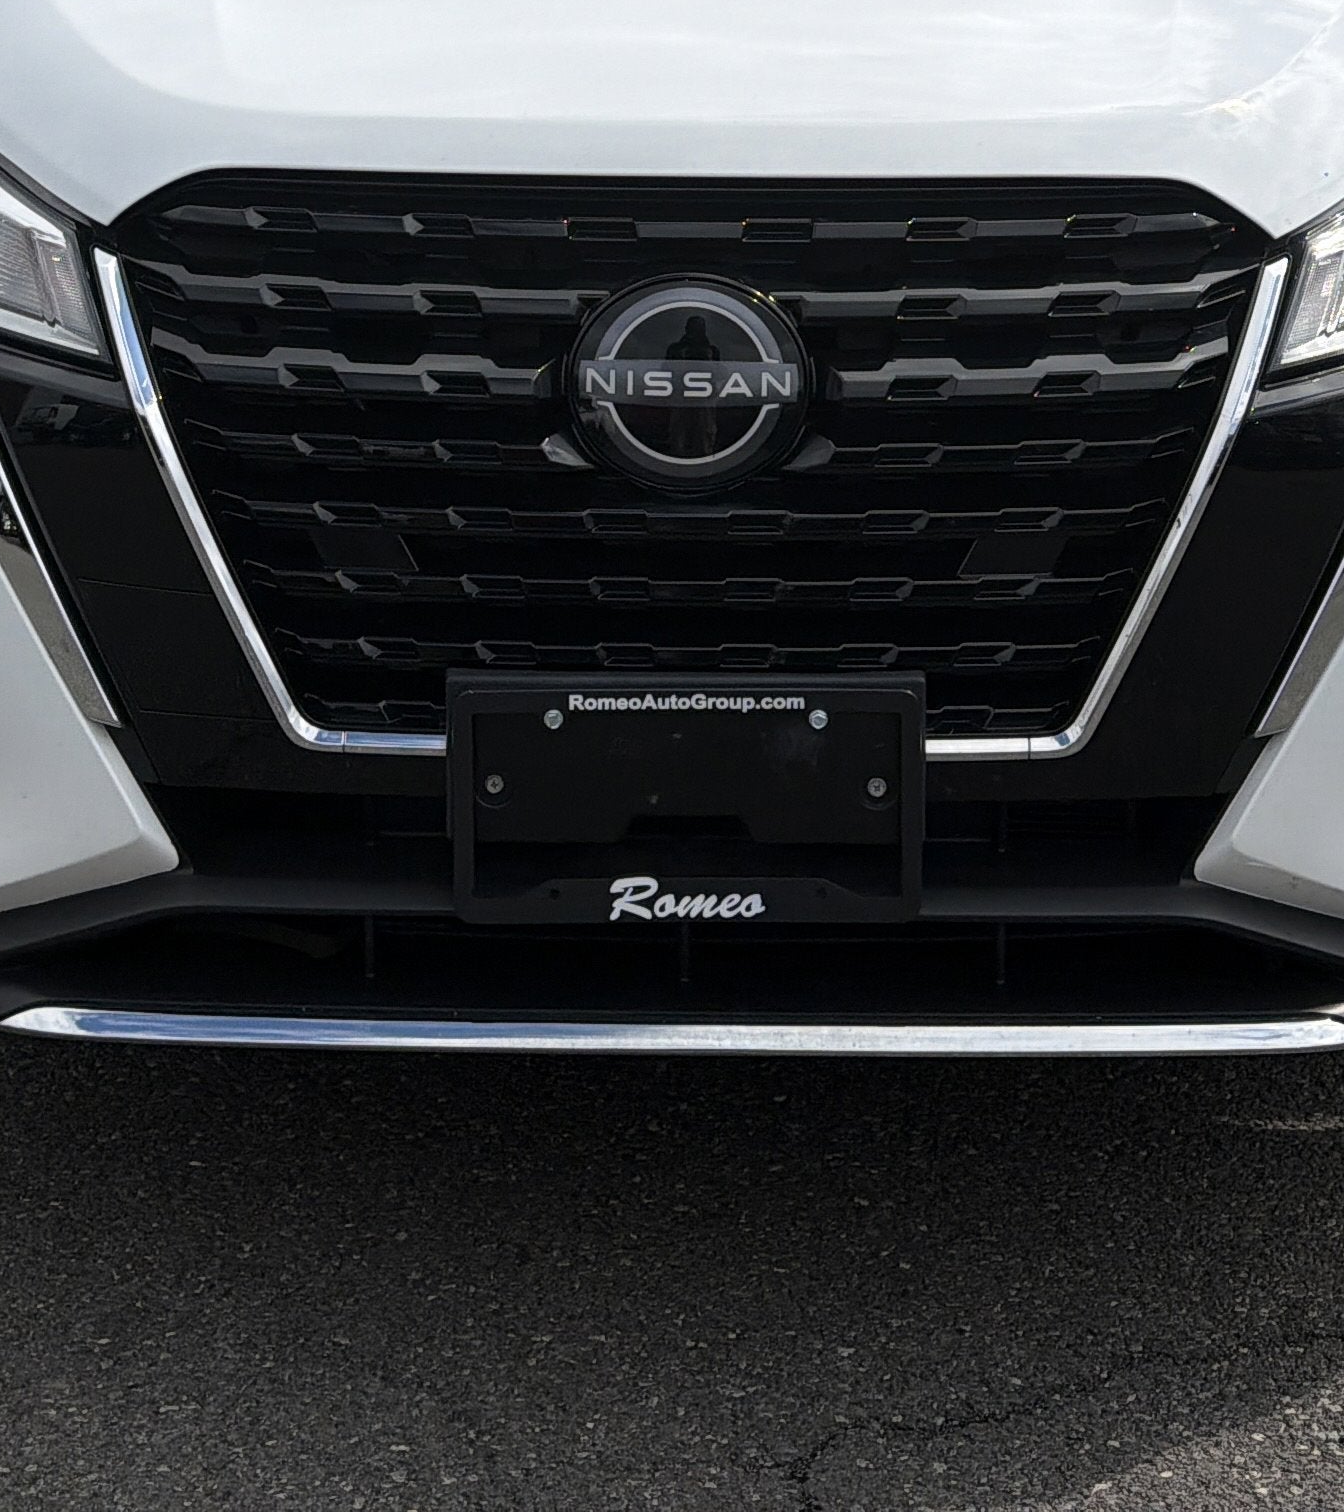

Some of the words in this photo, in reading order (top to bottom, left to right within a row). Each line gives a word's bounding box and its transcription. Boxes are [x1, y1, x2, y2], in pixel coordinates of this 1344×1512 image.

[585, 367, 791, 398] NISSAN
[568, 694, 805, 713] RomeoAutoGroup.com
[609, 876, 766, 921] Romeo
